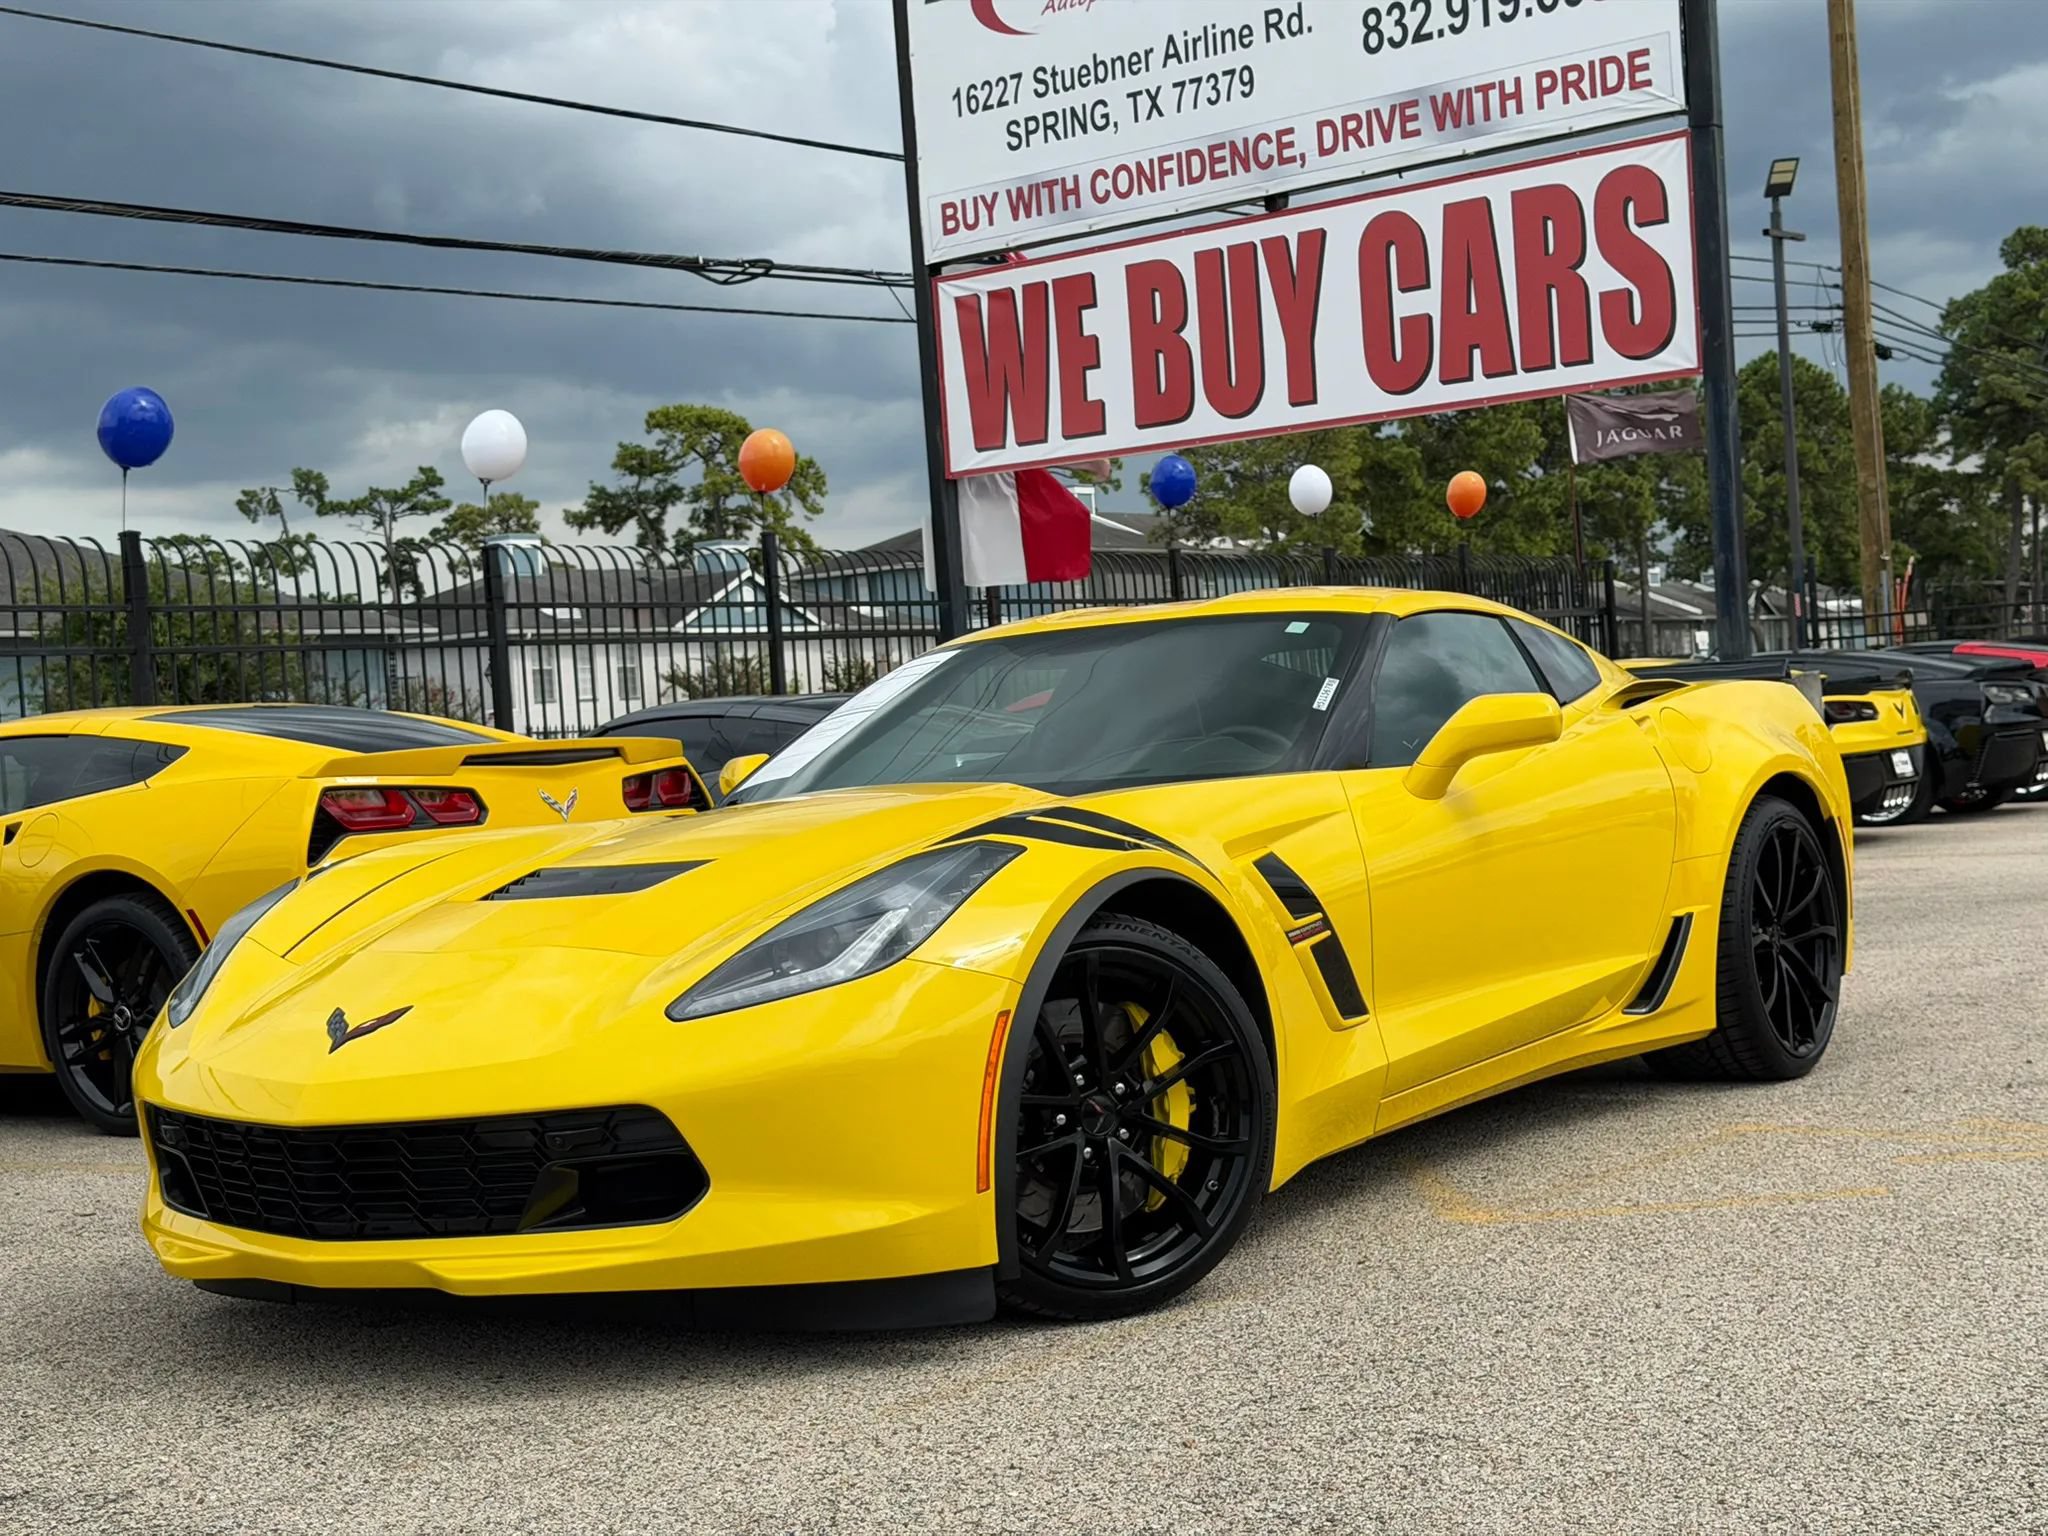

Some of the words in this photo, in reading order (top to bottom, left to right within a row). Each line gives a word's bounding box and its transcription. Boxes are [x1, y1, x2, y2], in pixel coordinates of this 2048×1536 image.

[952, 72, 1023, 118] 16227
[1032, 48, 1154, 99] Stuebner
[1161, 23, 1254, 69] Airline
[1264, 2, 1313, 43] Rd.
[1362, 0, 1607, 54] 832.919.
[941, 192, 999, 236] BUY
[1006, 174, 1081, 221] WITH
[1090, 127, 1307, 204] CONFIDENCE,
[1316, 99, 1421, 157] DRIVE
[1429, 77, 1524, 131] WITH
[1535, 48, 1653, 110] PRIDE
[1006, 98, 1119, 151] SPRING,
[1126, 86, 1165, 123] TX
[1172, 65, 1255, 114] 77379
[954, 271, 1105, 451] WE
[1124, 227, 1326, 429] BUY
[1358, 164, 1677, 395] CARS
[1596, 425, 1683, 448] JAGUAR
